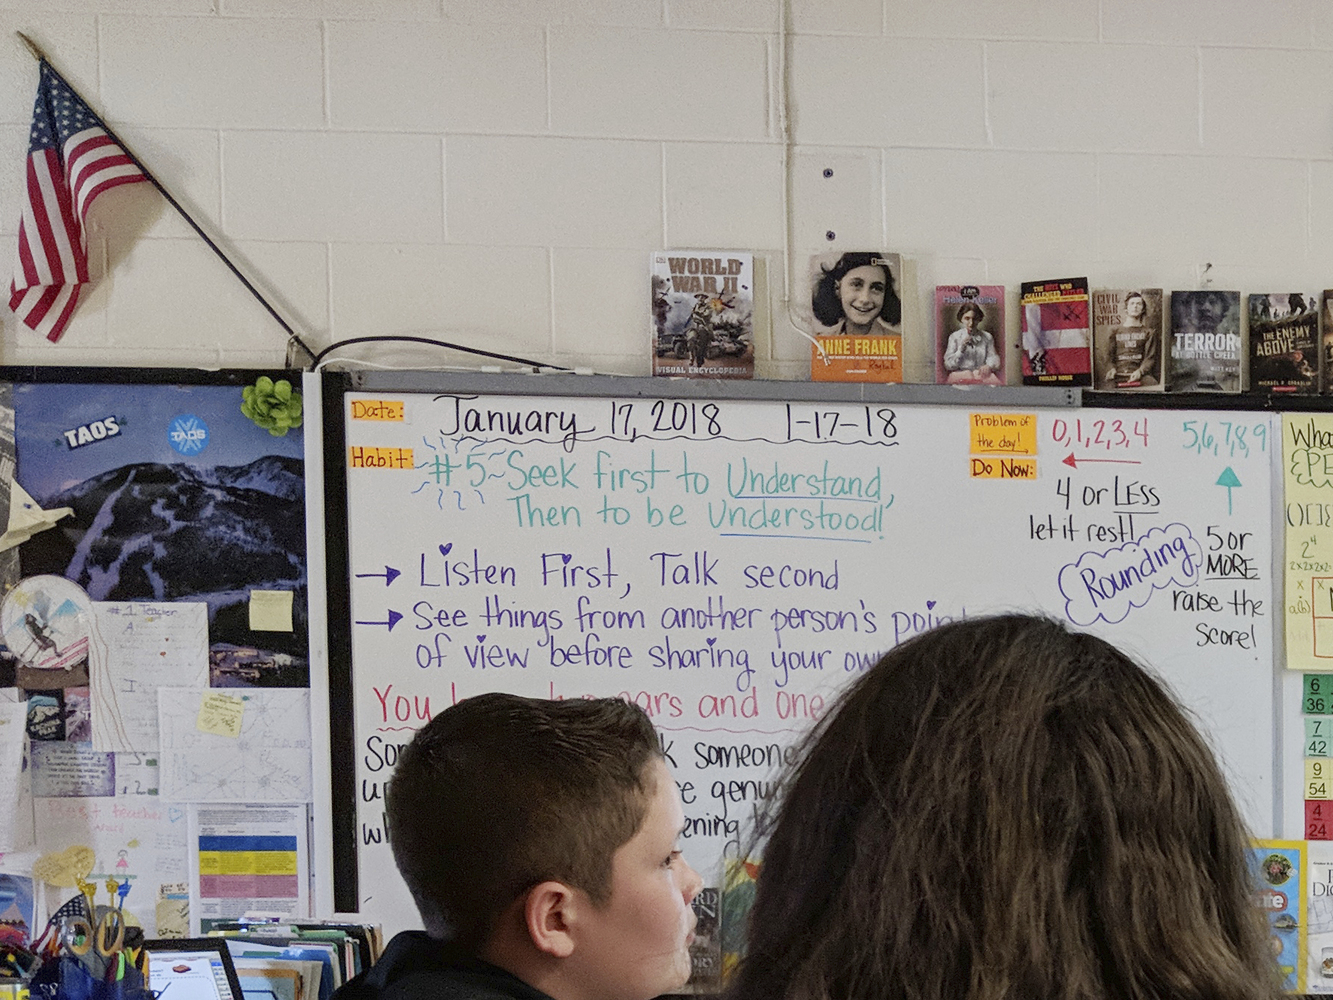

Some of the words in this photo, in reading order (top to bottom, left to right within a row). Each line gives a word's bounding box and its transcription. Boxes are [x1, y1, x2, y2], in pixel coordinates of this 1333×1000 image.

[668, 257, 742, 275] WORLD
[671, 276, 717, 293] WAR
[1097, 293, 1120, 304] CIVIL
[1099, 304, 1119, 314] WAR
[1096, 314, 1121, 326] SPIES
[1276, 325, 1311, 339] ENEMY
[816, 339, 851, 355] ANNE
[854, 339, 897, 355] FRANK
[1174, 333, 1237, 351] TERROR
[1257, 339, 1295, 356] ABOVE
[656, 366, 687, 374] VISUAL
[688, 366, 748, 375] ENCYCLOPEDIA
[64, 416, 120, 449] TAOS
[352, 401, 404, 420] Date:
[433, 395, 596, 453] January
[612, 401, 636, 442] 17,
[651, 400, 722, 436] 2018
[787, 403, 898, 441] 1-17-18
[974, 415, 1016, 427] Problem
[1019, 416, 1030, 427] of
[171, 430, 206, 441] TAOS
[977, 433, 999, 449] the
[1001, 432, 1022, 451] day!
[351, 448, 413, 469] Habit:
[506, 450, 579, 490] Seek
[593, 448, 670, 493] first
[676, 450, 710, 495] to
[727, 457, 895, 509] Understand,
[972, 460, 993, 477] Do
[1001, 460, 1034, 477] Now:
[1056, 476, 1071, 510] 4
[1082, 486, 1109, 505] or
[1114, 476, 1161, 507] LESS
[506, 493, 581, 528] Then
[596, 495, 631, 526] to
[647, 496, 687, 528] be
[708, 499, 886, 541] Understood!
[1030, 514, 1059, 541] let
[1063, 514, 1080, 541] it
[1207, 525, 1222, 551] 5
[1227, 531, 1252, 550] or
[420, 543, 516, 587] Listen
[541, 547, 631, 599] First,
[650, 551, 719, 586] Talk
[743, 559, 839, 590] second
[1080, 535, 1197, 608] Rounding
[1205, 554, 1259, 579] MORE
[1172, 585, 1224, 613] raise
[1227, 589, 1266, 616] the
[412, 600, 469, 630] See
[479, 594, 563, 647] things
[574, 595, 645, 632] from
[660, 595, 762, 631] another
[770, 599, 878, 649] person's
[416, 633, 452, 668] of
[464, 634, 530, 669] view
[551, 633, 633, 668] before
[649, 635, 756, 692] sharing
[771, 648, 832, 688] your
[374, 683, 431, 723] You
[698, 686, 759, 718] and
[776, 691, 824, 720] one
[694, 741, 798, 769] someone
